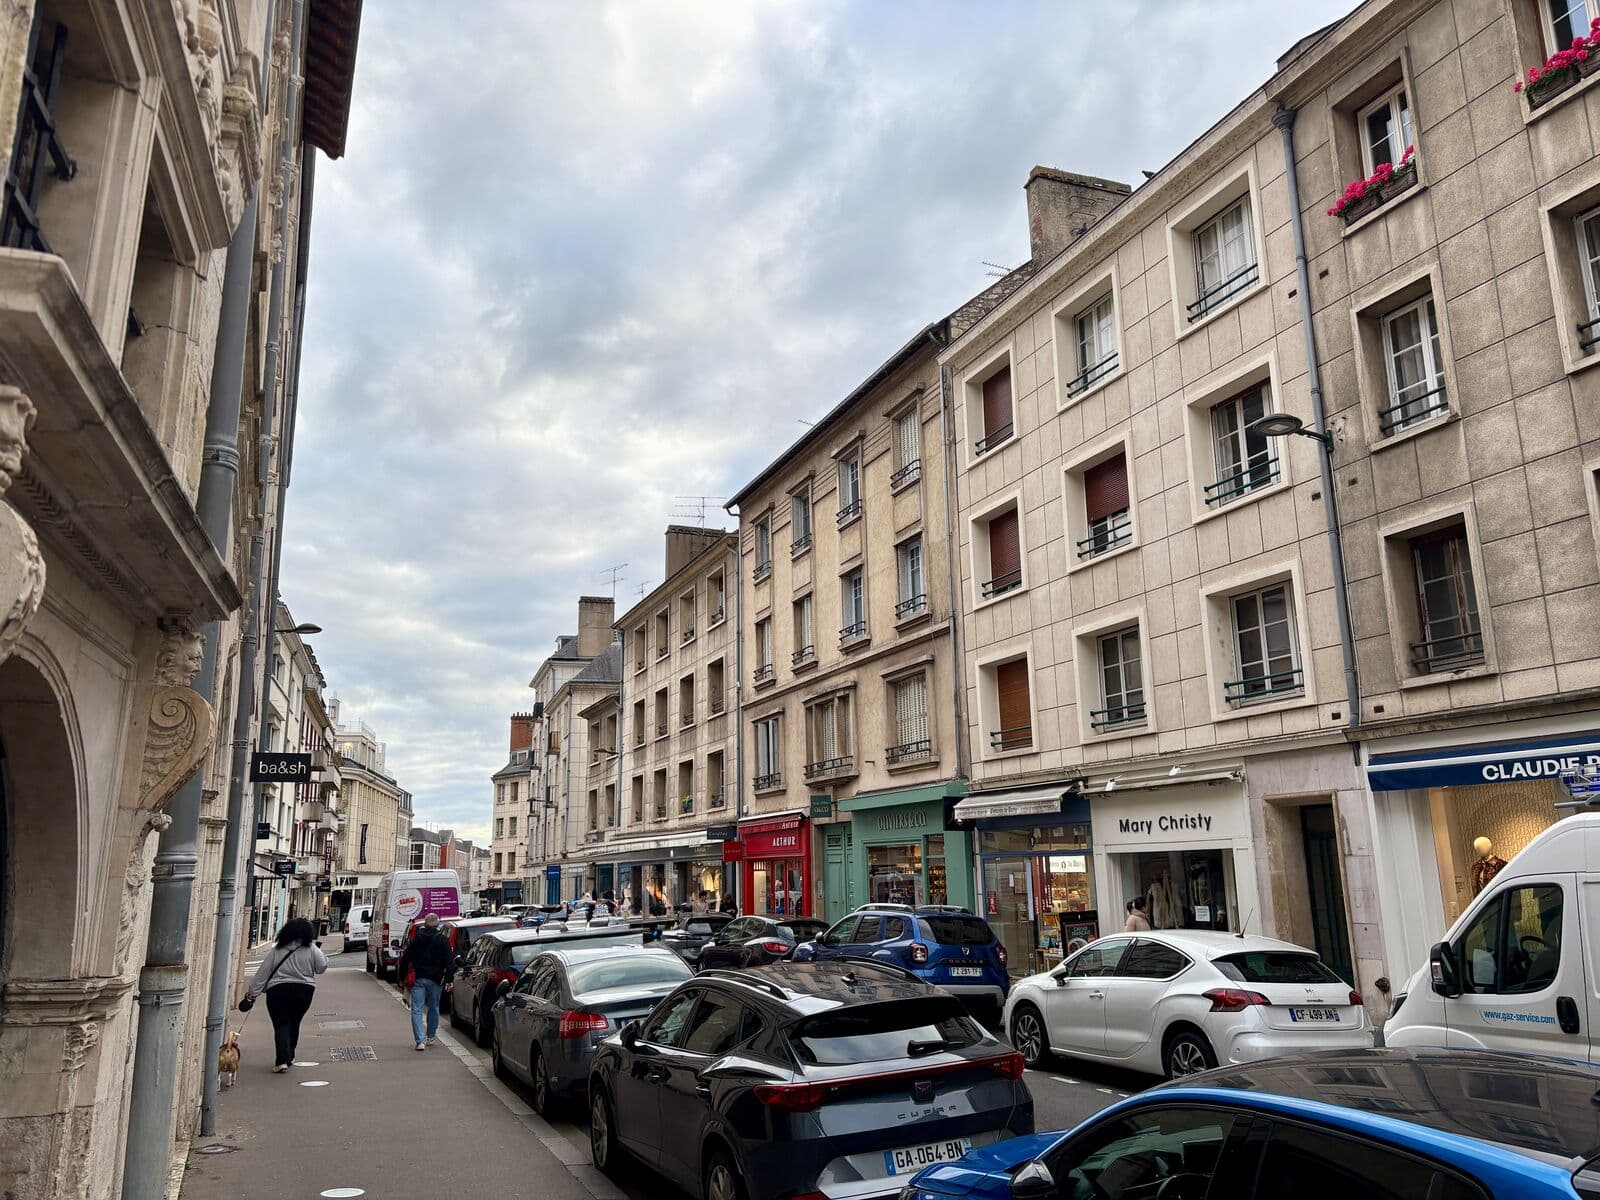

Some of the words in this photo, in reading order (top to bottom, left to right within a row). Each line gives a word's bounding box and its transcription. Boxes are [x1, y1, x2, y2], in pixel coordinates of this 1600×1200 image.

[259, 760, 307, 775] ba&sh
[1119, 818, 1152, 835] Mary
[1158, 813, 1212, 832] Christy
[772, 836, 797, 847] ARTHUR
[1484, 1011, 1556, 1025] www.gaz-service.com
[897, 1105, 957, 1120] CUPRA
[896, 1140, 964, 1169] GA-064-BN
